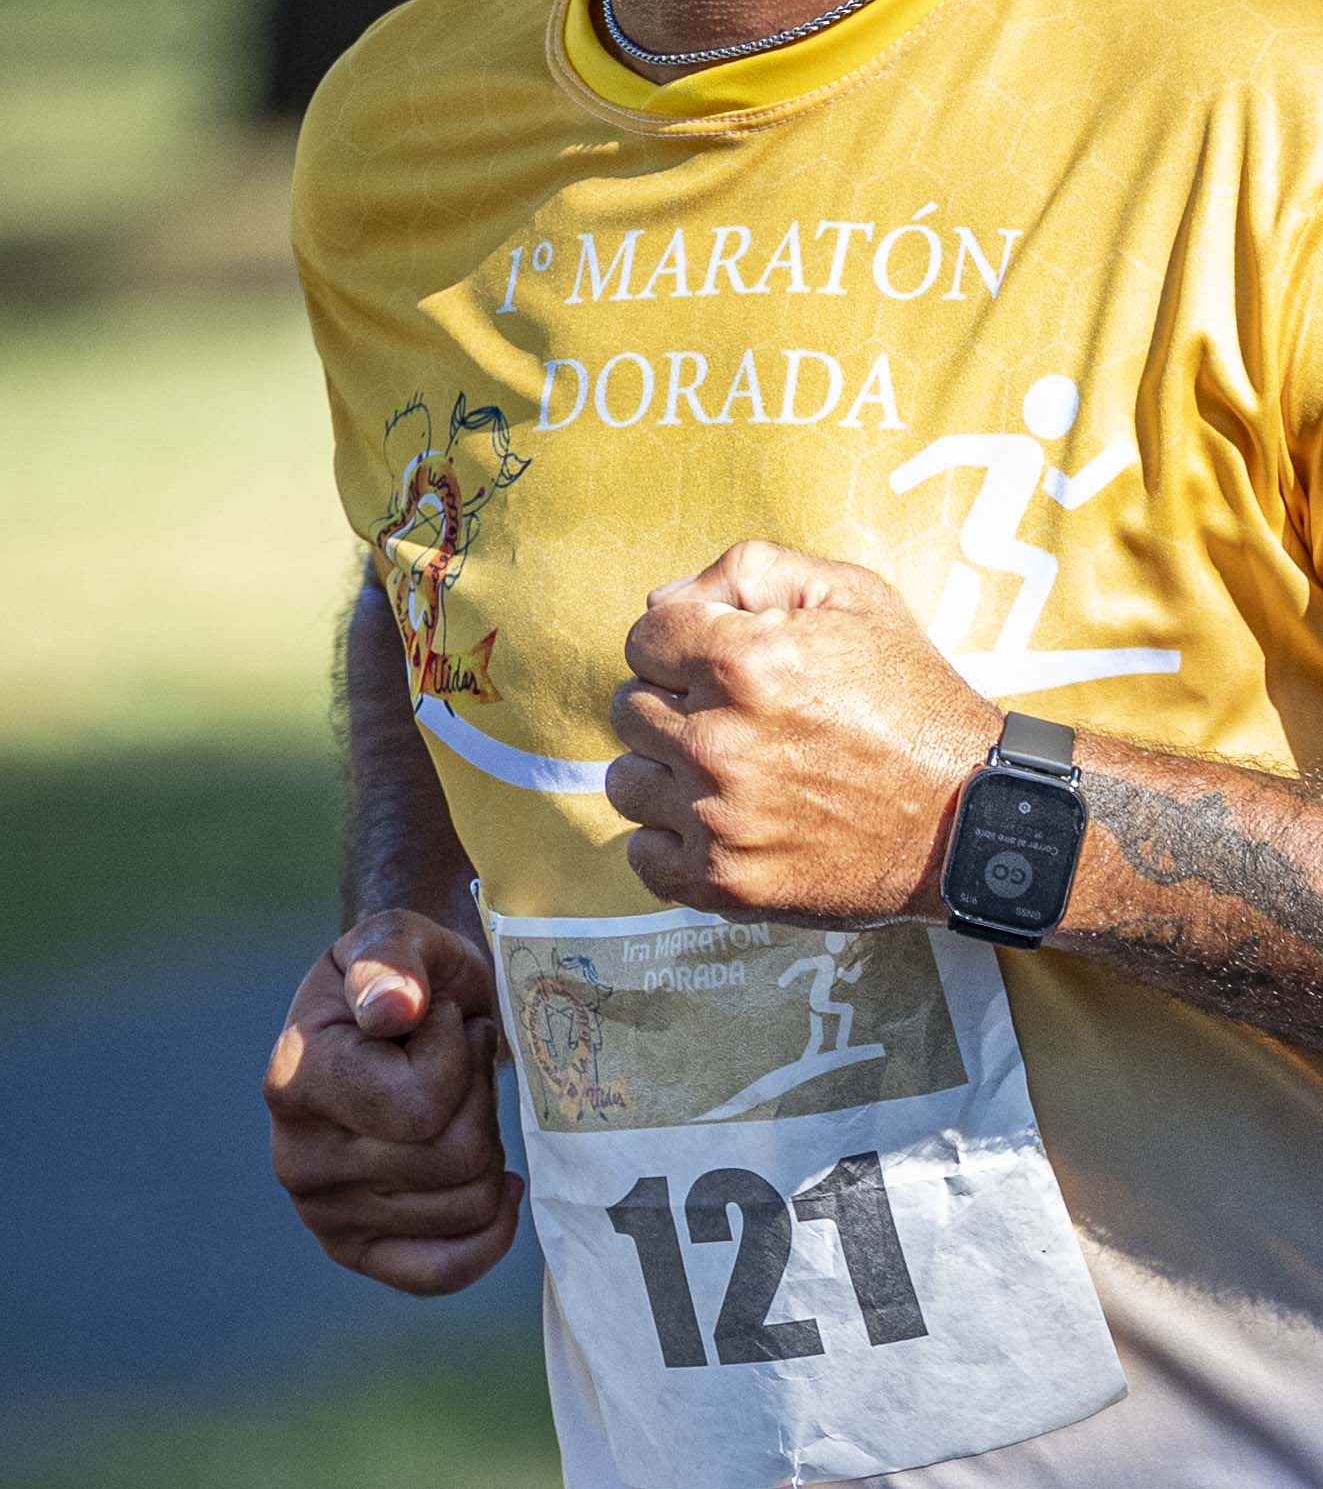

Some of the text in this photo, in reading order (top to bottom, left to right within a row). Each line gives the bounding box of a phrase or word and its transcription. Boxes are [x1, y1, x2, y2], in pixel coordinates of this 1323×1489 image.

[563, 202, 1023, 305] MARATÓN
[533, 348, 907, 432] DORADA
[992, 863, 1026, 885] GO
[644, 962, 745, 992] DORADA
[605, 1149, 930, 1368] 121
